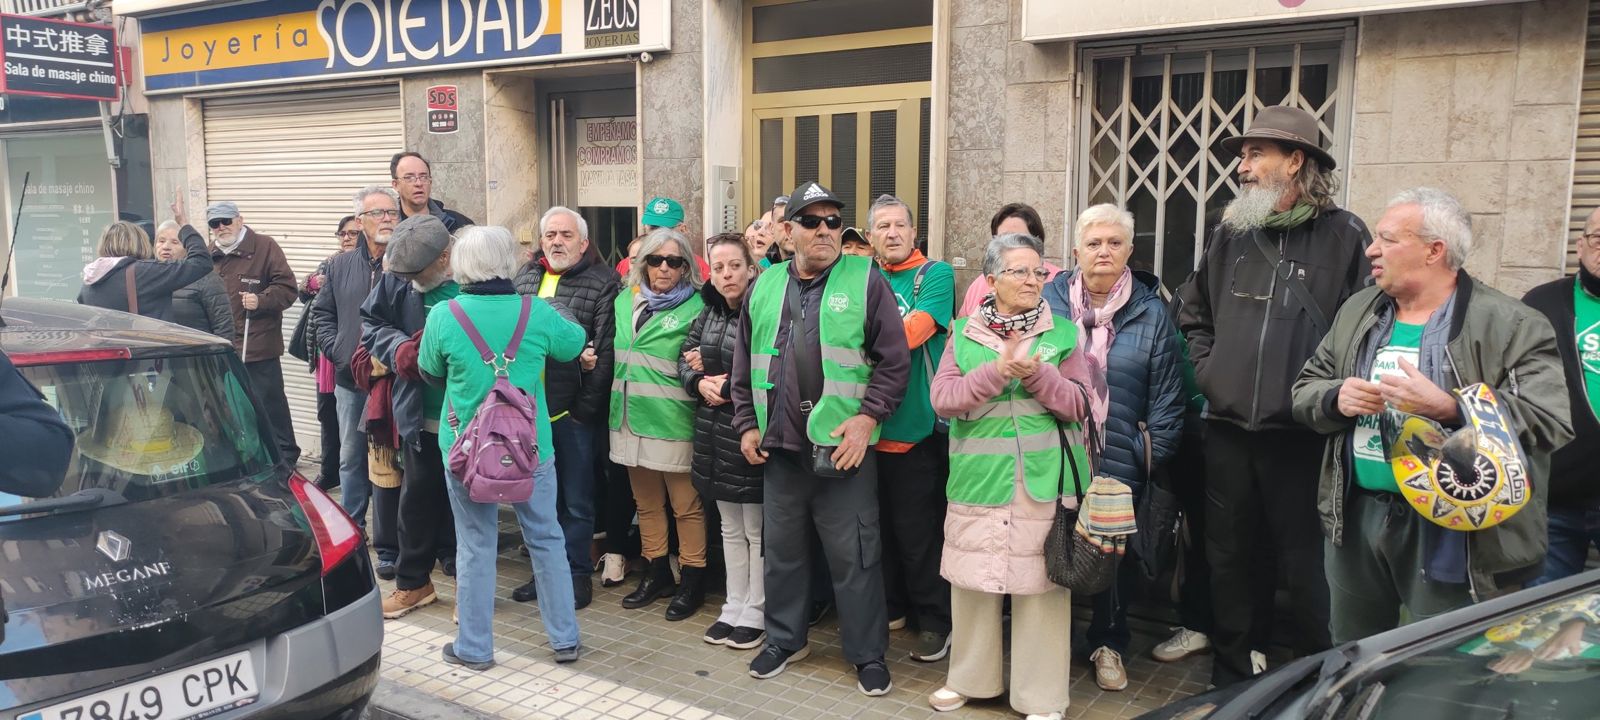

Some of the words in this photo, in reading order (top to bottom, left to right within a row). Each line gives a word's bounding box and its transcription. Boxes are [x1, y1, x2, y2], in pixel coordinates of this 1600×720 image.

[586, 0, 638, 31] ZEUS
[6, 24, 109, 56] 中式推拿
[161, 23, 308, 65] Joyería
[316, 0, 549, 69] SOLEDAD
[585, 32, 640, 48] JOYERIAS
[4, 61, 29, 77] Sala
[31, 64, 46, 77] de
[48, 68, 87, 84] masaje
[89, 71, 117, 84] chino
[429, 90, 455, 107] SDS
[578, 145, 637, 165] COMPRAMOS
[39, 184, 47, 195] de
[48, 182, 73, 197] masaje
[74, 183, 95, 195] chino
[803, 191, 829, 201] adidas
[182, 660, 249, 707] CPK
